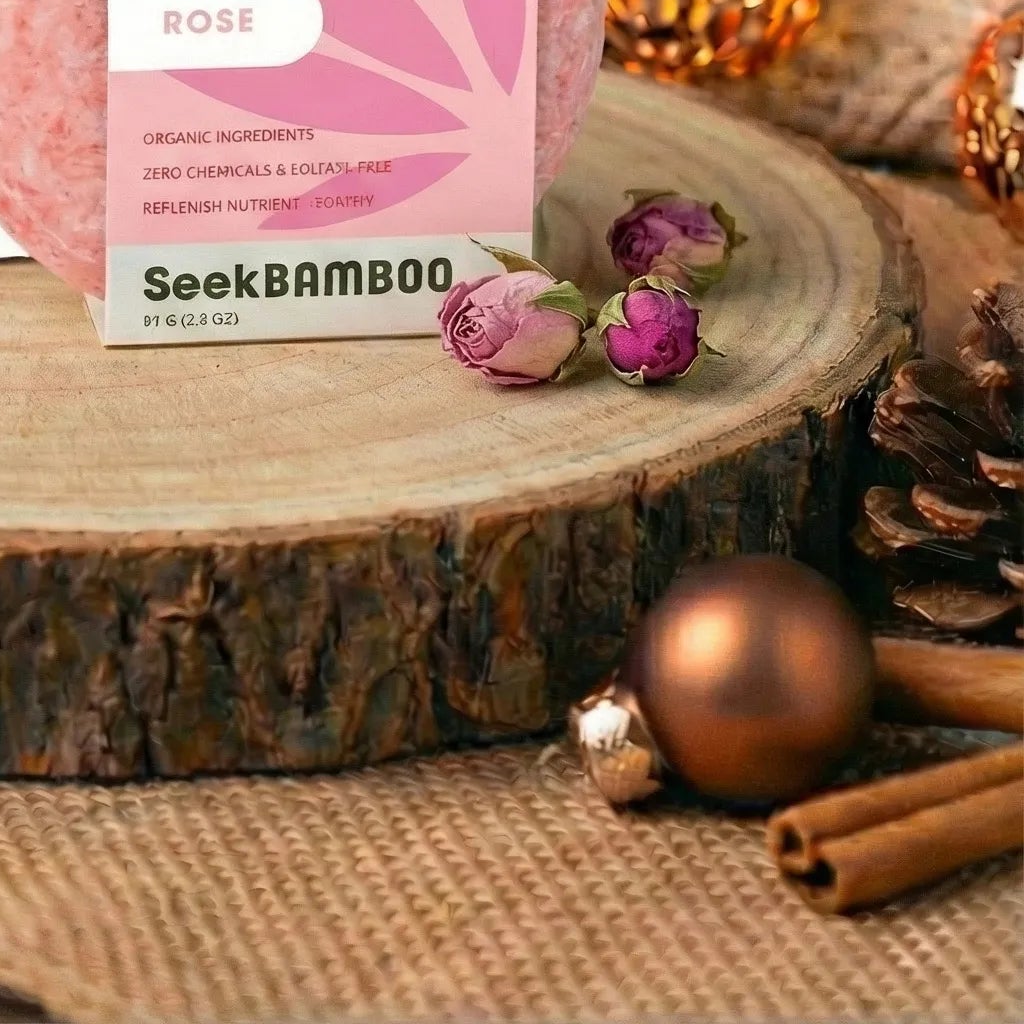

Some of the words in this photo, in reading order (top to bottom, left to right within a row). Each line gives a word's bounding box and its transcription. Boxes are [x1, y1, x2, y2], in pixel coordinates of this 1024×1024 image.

[163, 8, 253, 34] ROSE
[143, 131, 212, 145] ORGANIC
[216, 128, 315, 143] INGREDIENTS
[143, 167, 182, 180] ZERO
[276, 163, 286, 176] &
[227, 197, 300, 213] NUTRIENT
[143, 257, 453, 301] SeekBAMBOO
[165, 314, 177, 327] G
